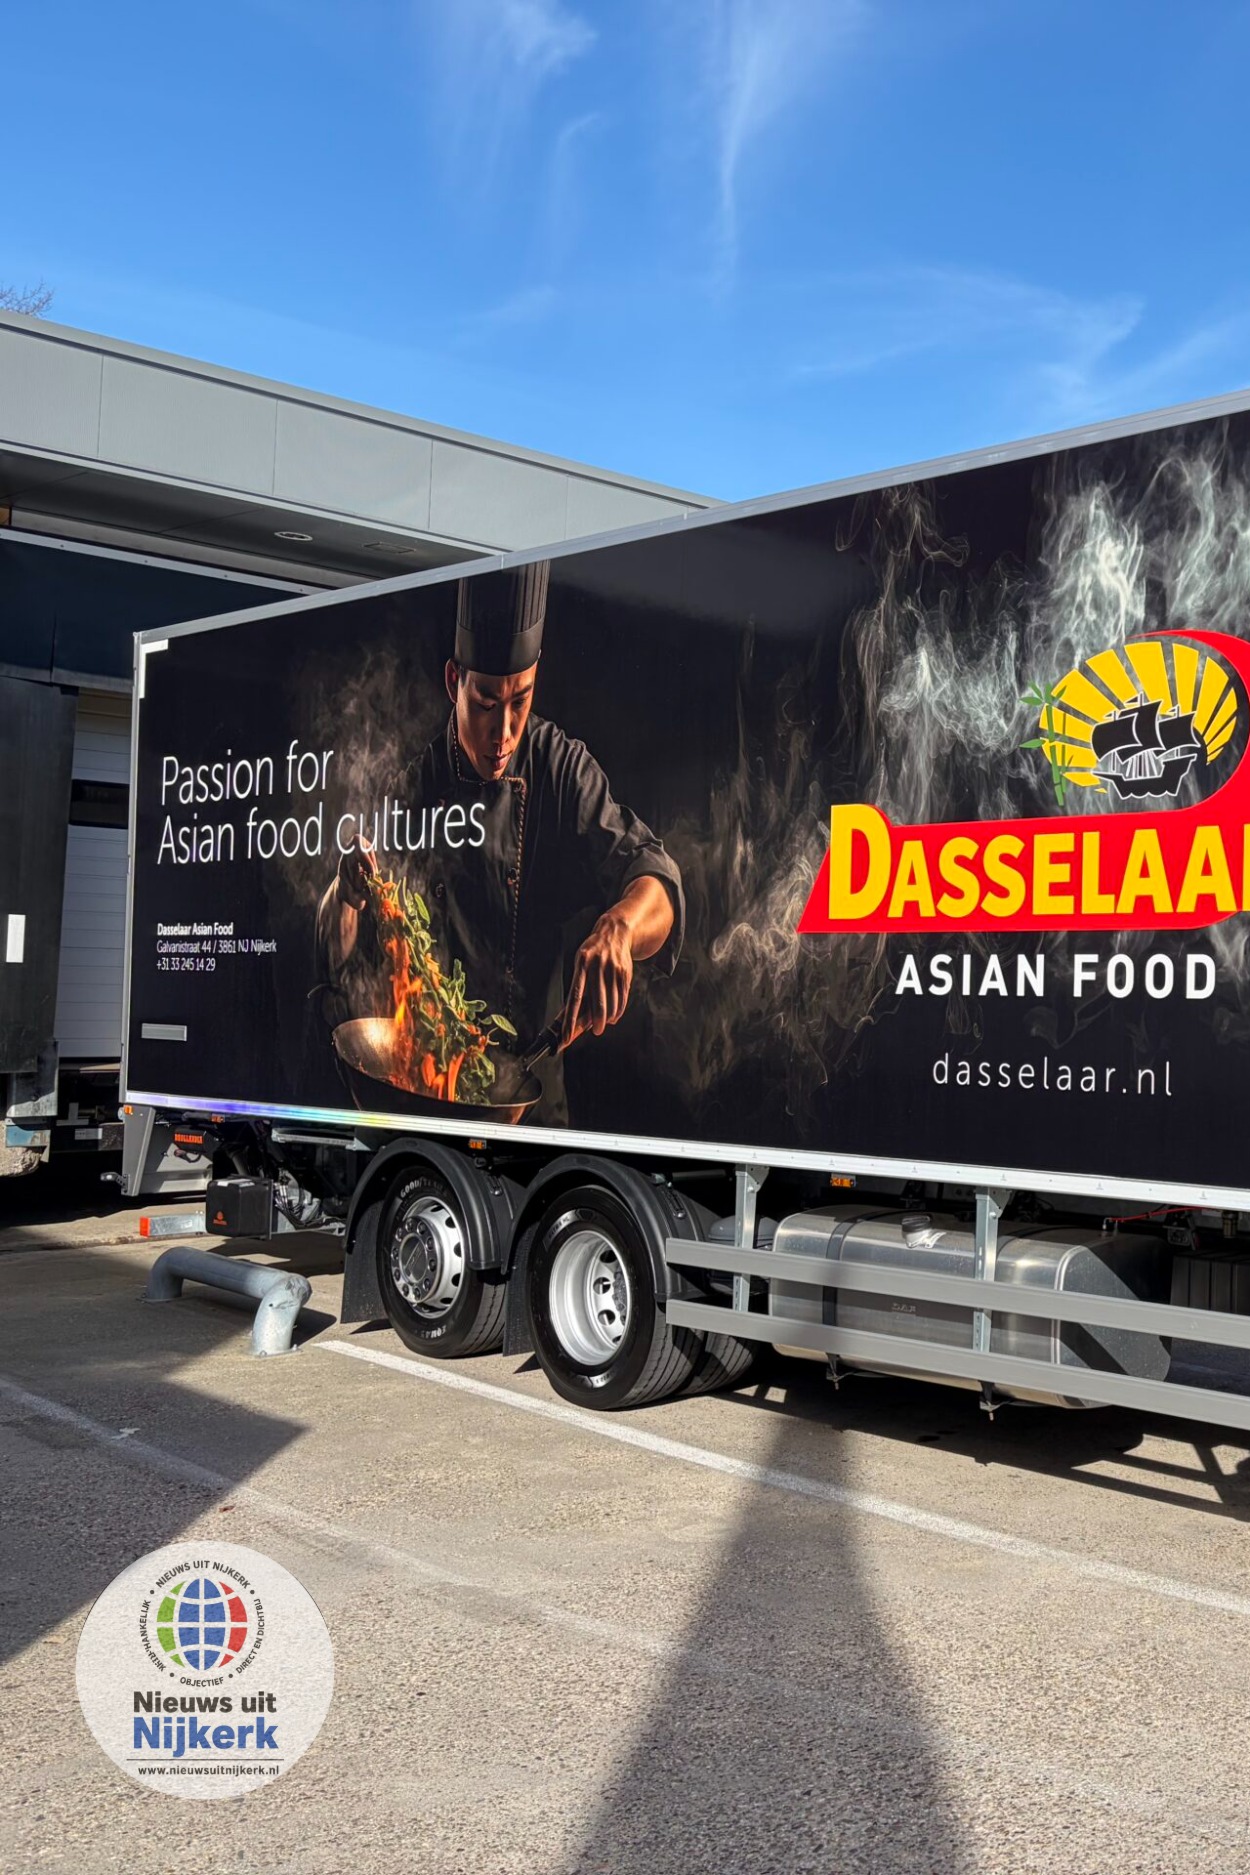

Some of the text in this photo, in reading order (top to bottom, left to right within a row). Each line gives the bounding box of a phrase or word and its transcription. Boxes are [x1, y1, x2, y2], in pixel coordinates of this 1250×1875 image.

[162, 740, 334, 805] Passion for
[157, 796, 486, 864] Asian food cultures
[156, 940, 200, 953] Galvanistraat
[201, 940, 212, 953] 44
[218, 939, 237, 954] 3861
[237, 939, 249, 953] NJ
[250, 938, 277, 956] Nijkerk
[157, 922, 234, 936] Dasselaar Asian Food
[156, 957, 216, 971] +31 33 245 14 29
[895, 953, 1217, 999] ASIAN FOOD
[932, 1053, 1173, 1097] dasselaar.nl
